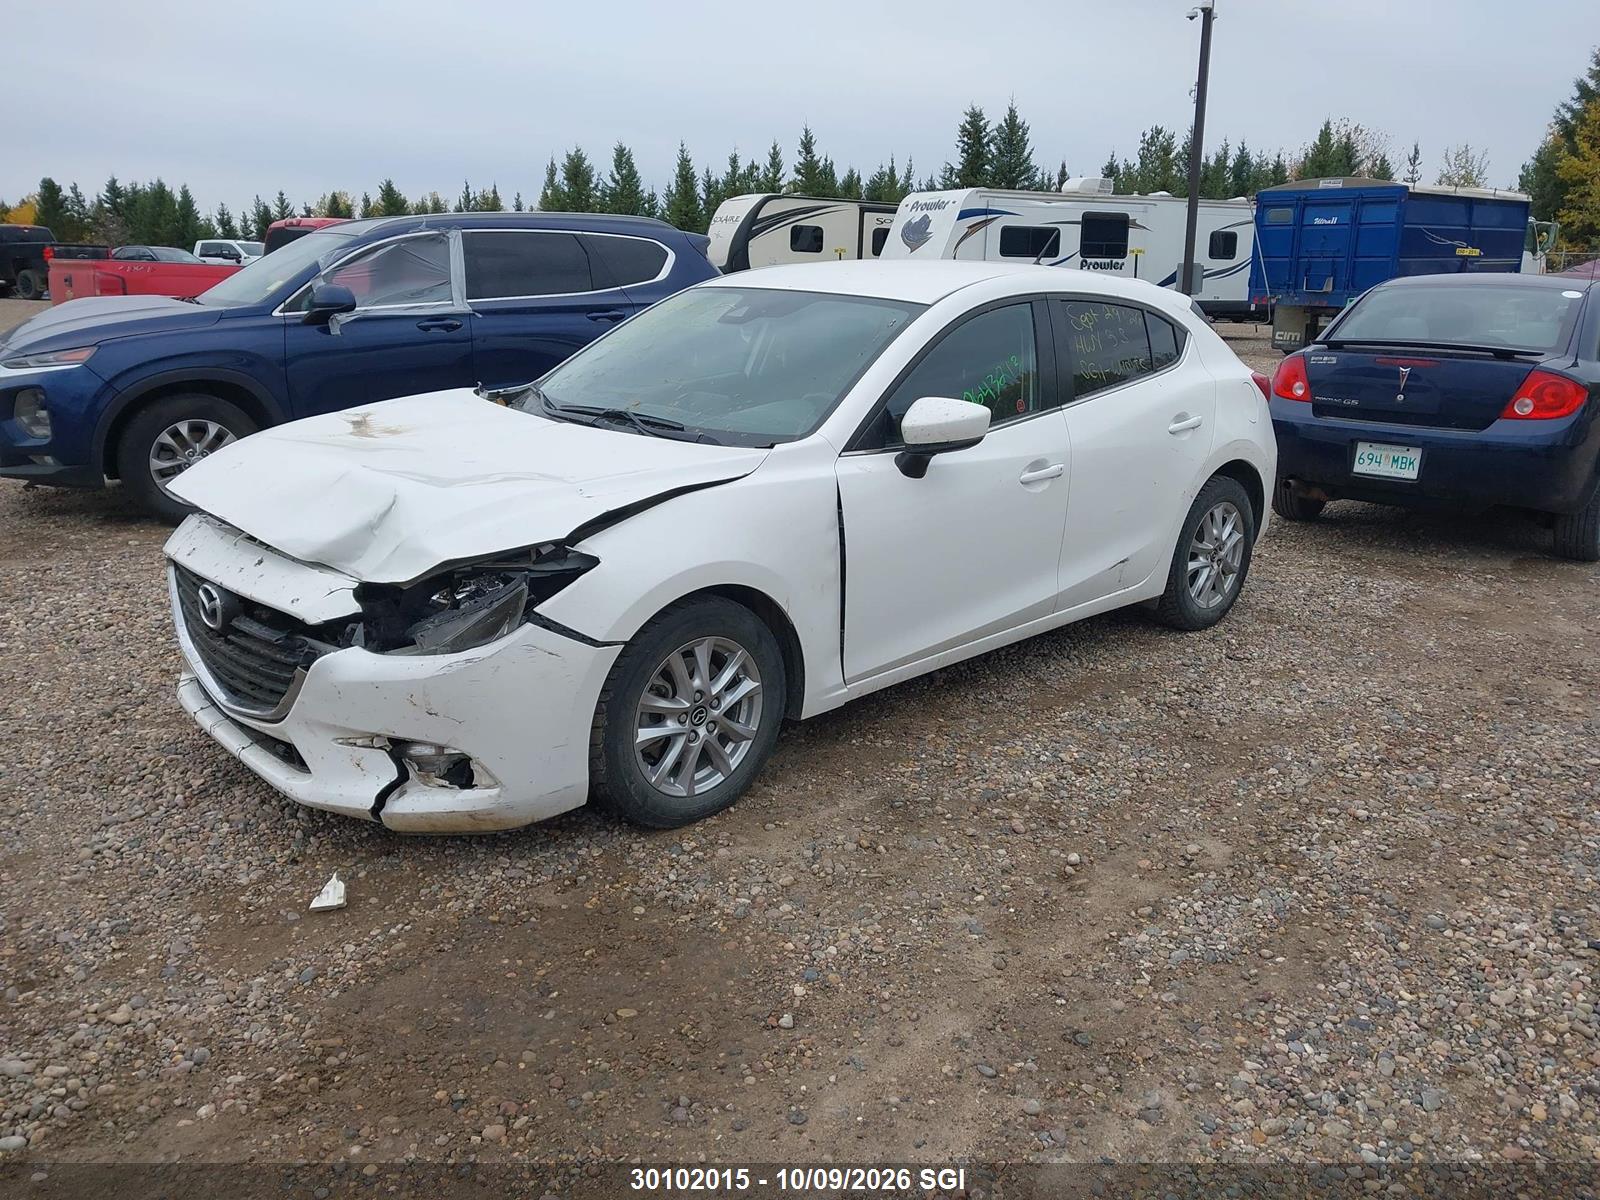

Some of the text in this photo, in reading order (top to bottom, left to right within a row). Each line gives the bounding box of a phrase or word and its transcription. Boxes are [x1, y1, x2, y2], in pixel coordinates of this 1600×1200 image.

[910, 199, 951, 212] Prowler
[876, 217, 895, 226] SO
[1080, 259, 1125, 270] Prowler
[1357, 452, 1417, 471] 694 MBK
